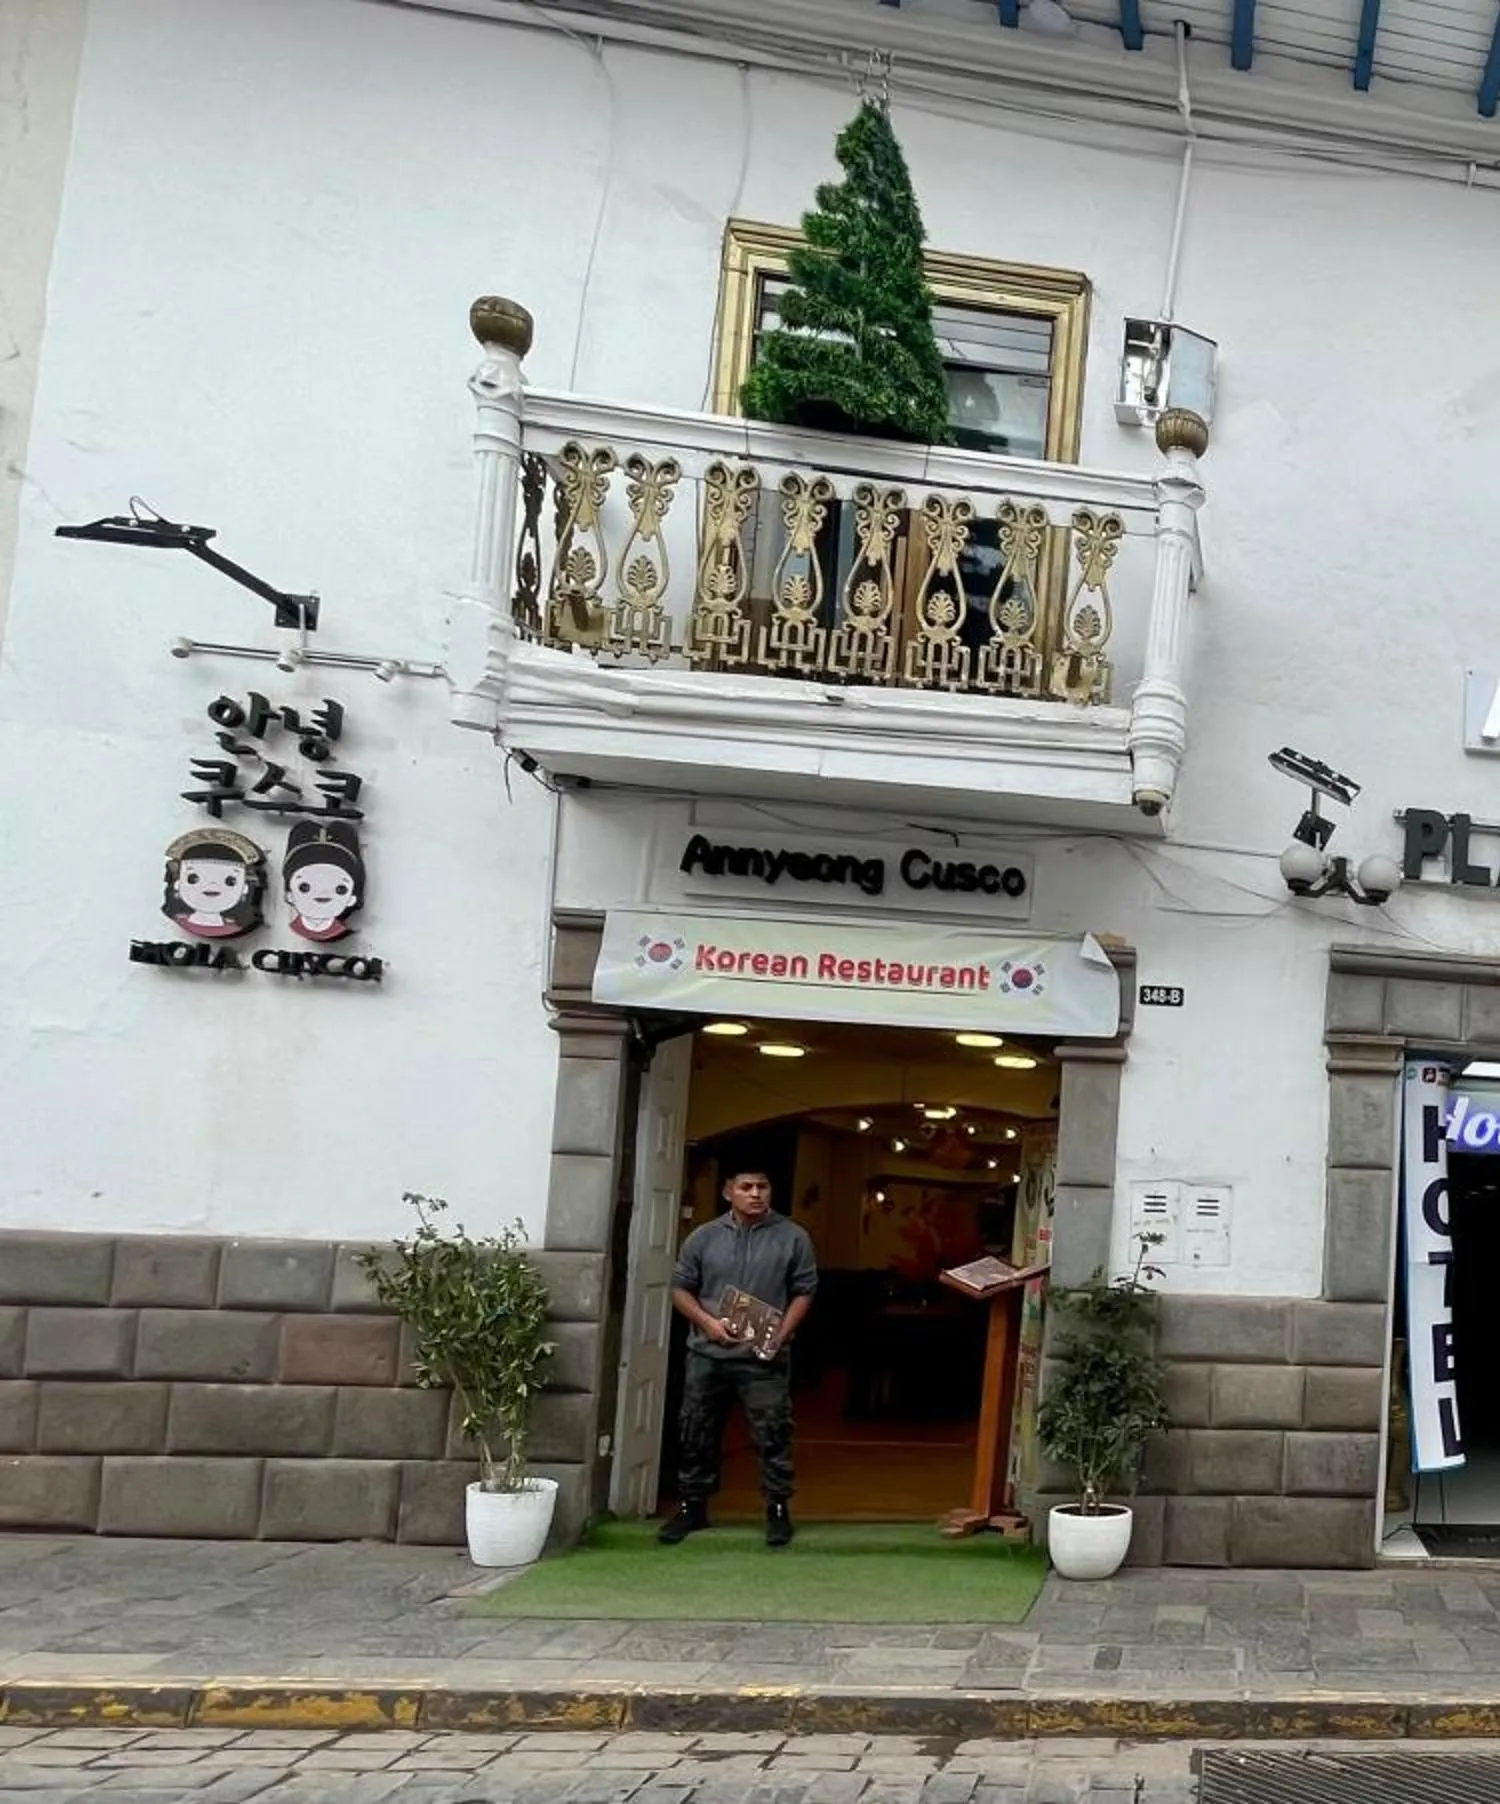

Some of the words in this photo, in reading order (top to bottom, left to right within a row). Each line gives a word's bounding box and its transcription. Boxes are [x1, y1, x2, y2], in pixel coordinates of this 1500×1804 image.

[207, 691, 344, 762] 안녕
[180, 757, 364, 819] 쿠스코
[680, 833, 885, 895] Annyeong
[900, 849, 1026, 897] Cusco
[694, 944, 809, 979] Korean
[816, 952, 991, 991] Restaurant
